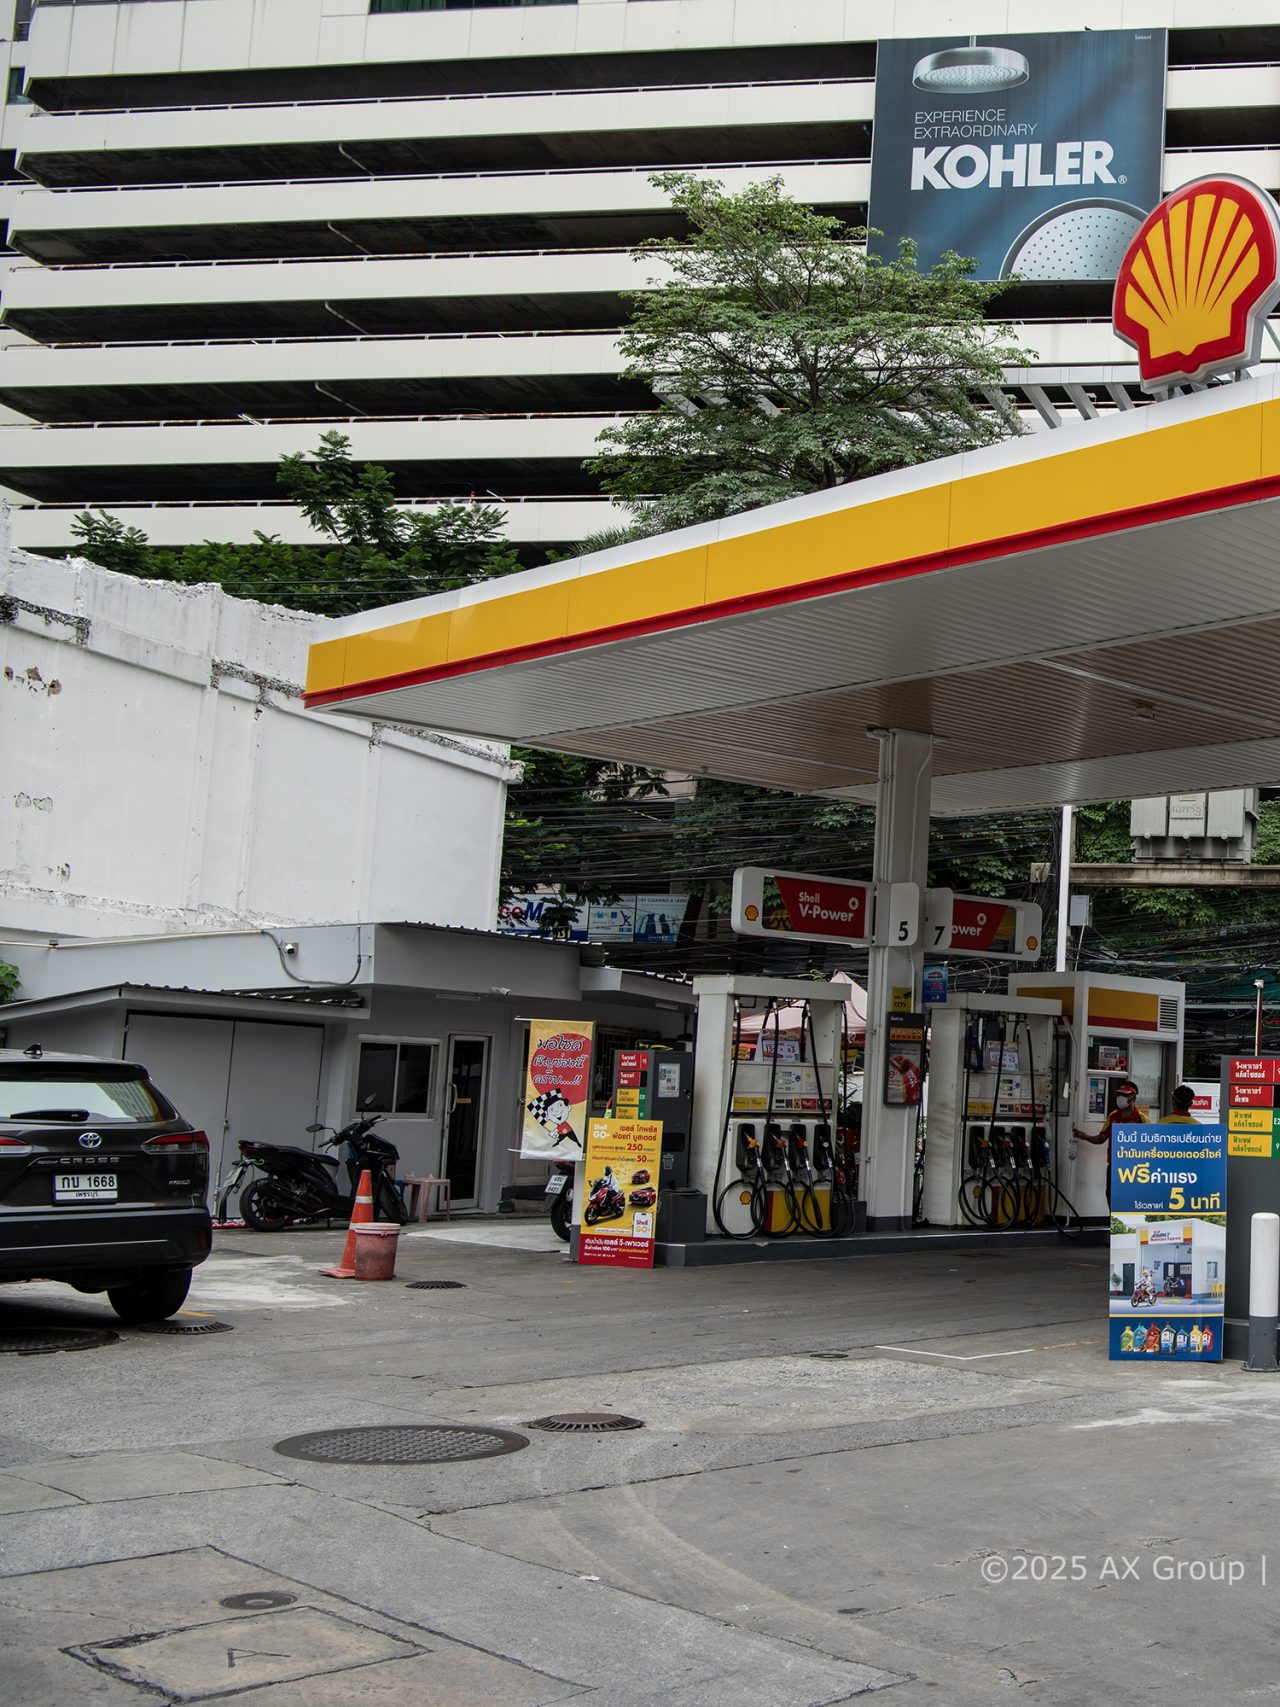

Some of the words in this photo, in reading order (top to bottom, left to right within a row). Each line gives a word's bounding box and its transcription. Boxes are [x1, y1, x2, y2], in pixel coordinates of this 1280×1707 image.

[914, 108, 1006, 125] EXPERIENCE
[913, 123, 1038, 140] EXTRAORDINARY
[798, 892, 820, 904] Shell
[800, 905, 854, 922] V-Power
[898, 920, 909, 942] 5
[934, 926, 945, 946] 7
[952, 924, 982, 937] ower
[1140, 1132, 1222, 1144] มีบริการเปลี่ยนถ่าย
[627, 1143, 644, 1152] 250
[1117, 1146, 1222, 1159] น้ำมันเครื่องมอเตอร์ไซค์
[60, 1156, 120, 1164] CROSS
[636, 1154, 647, 1162] 50
[87, 1176, 115, 1188] 1668
[1168, 1187, 1186, 1210] 5
[1190, 1192, 1220, 1210] นาที
